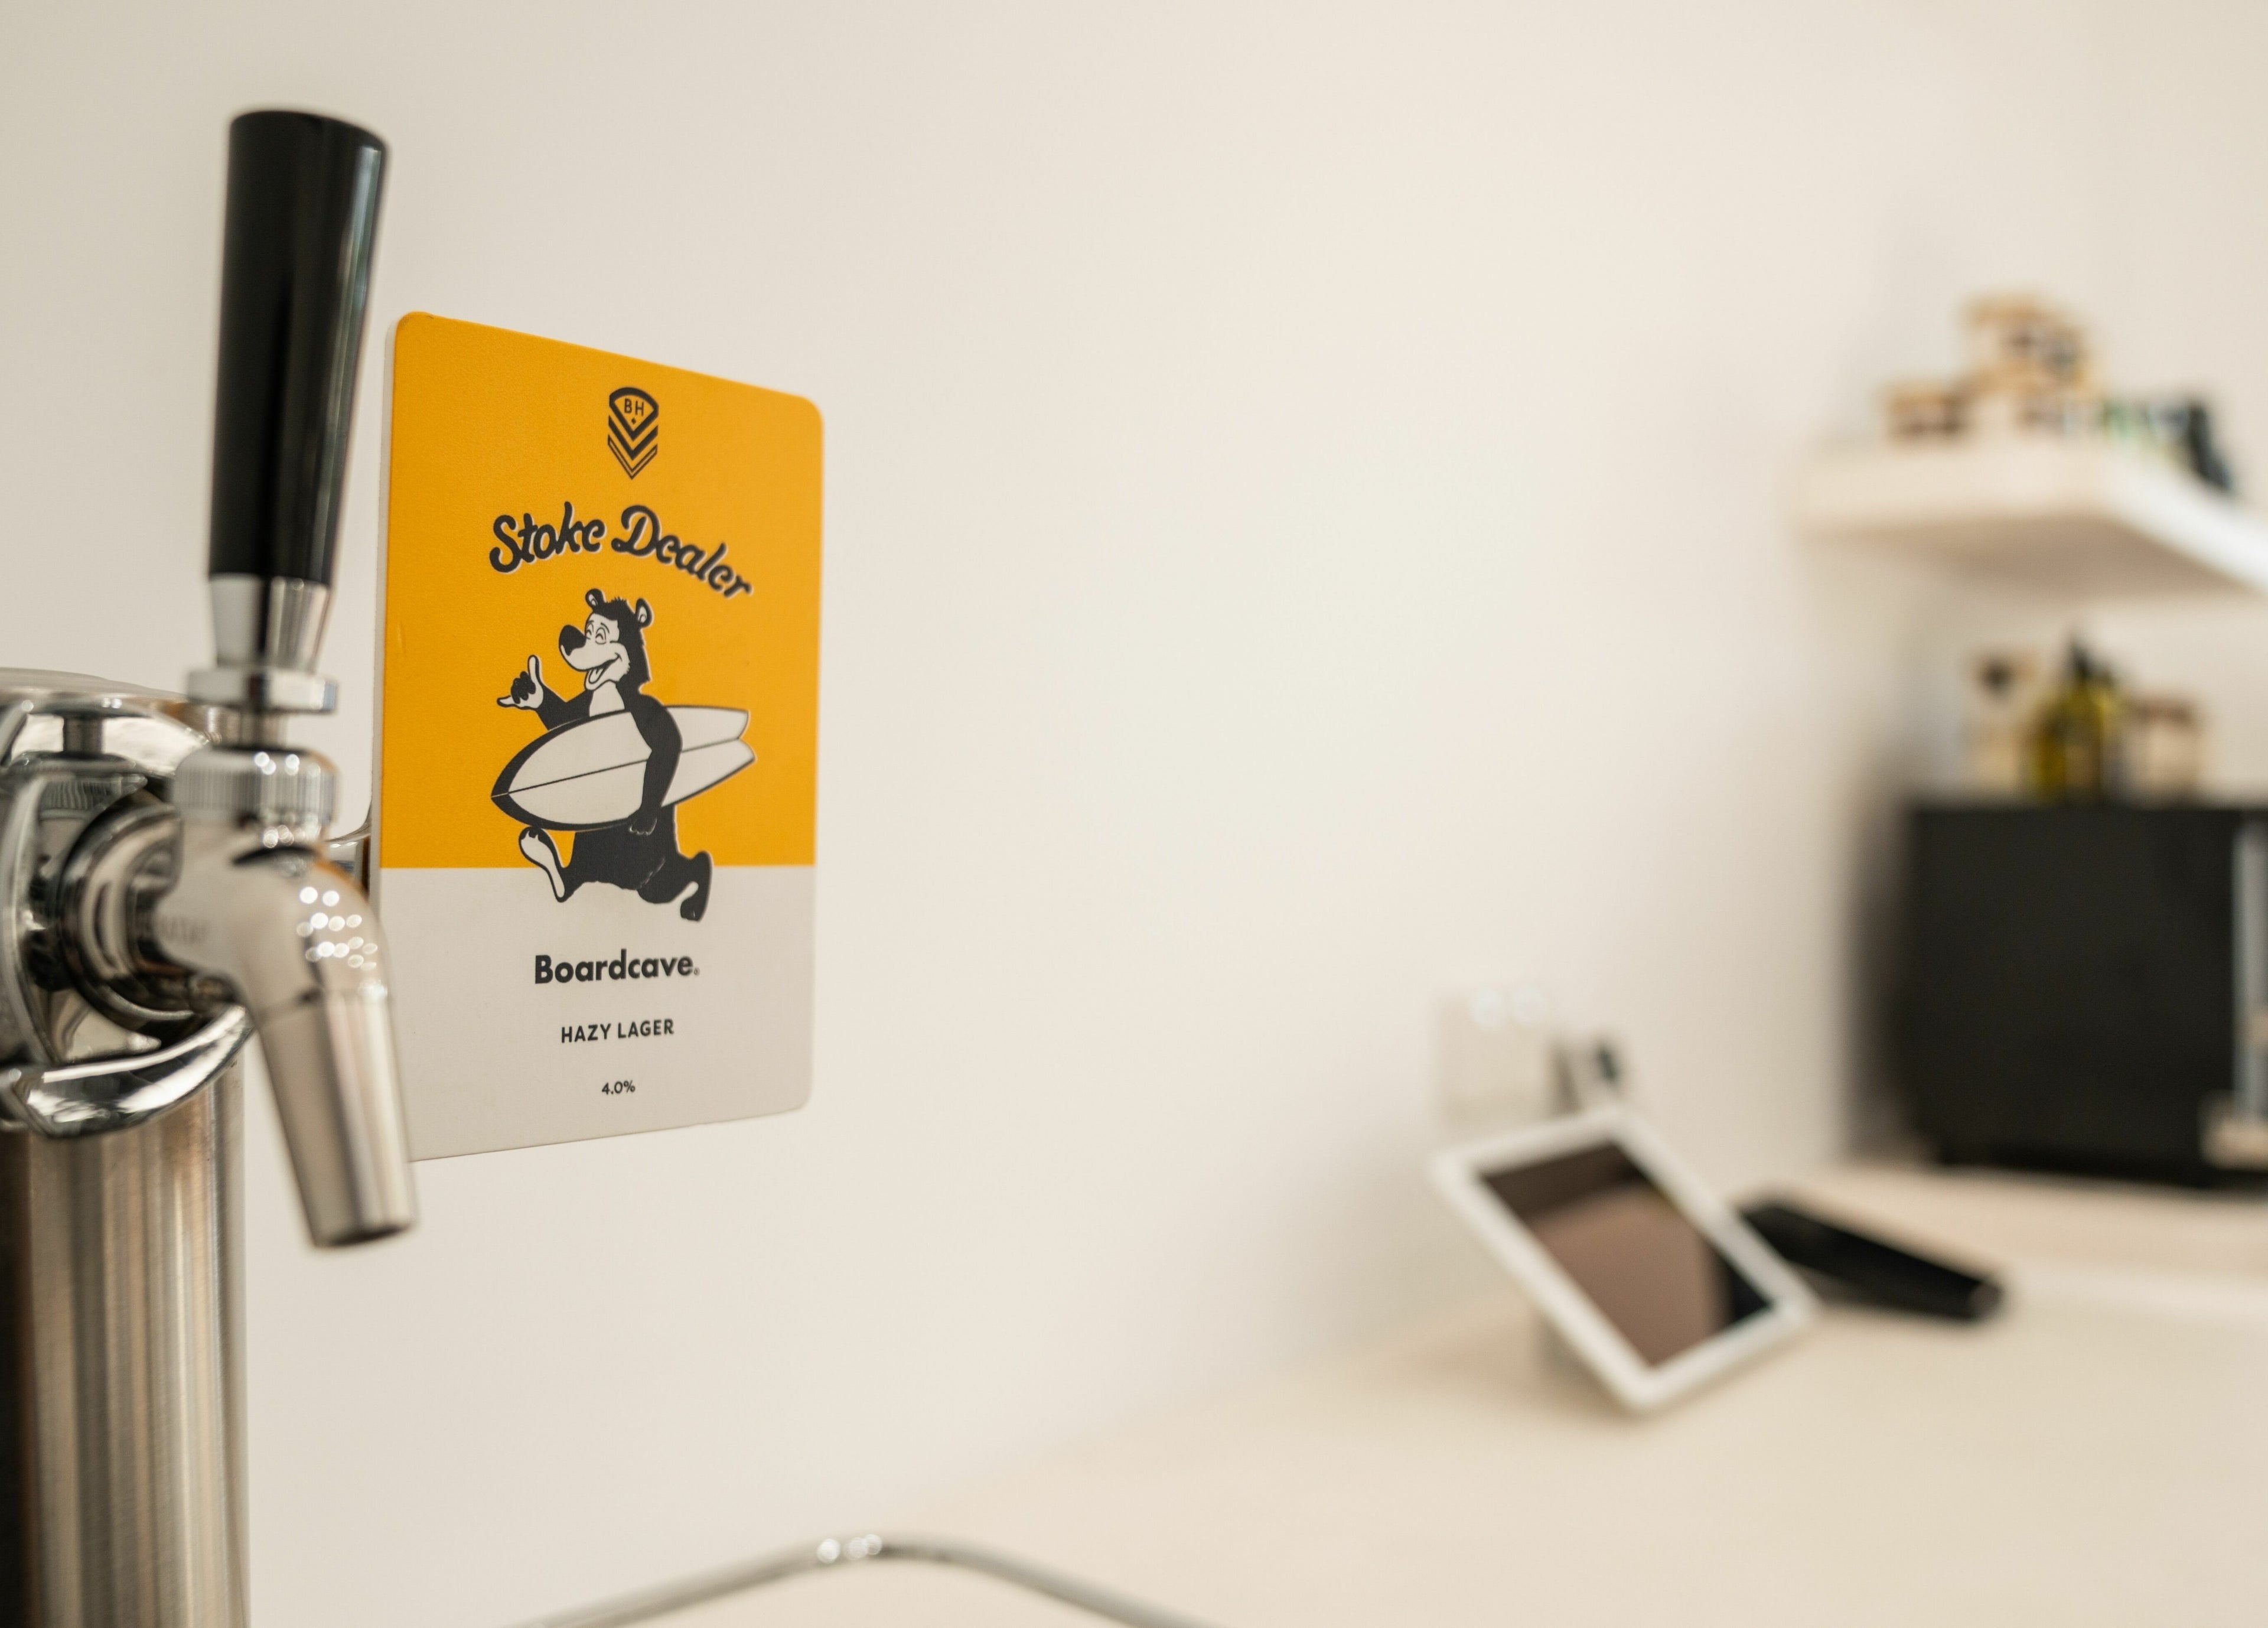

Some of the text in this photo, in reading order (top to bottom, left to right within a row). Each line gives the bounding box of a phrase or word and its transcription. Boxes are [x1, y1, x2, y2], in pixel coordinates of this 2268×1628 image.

[624, 398, 644, 416] BH
[489, 501, 753, 599] Stoke Dealer
[561, 1018, 675, 1044] HAZY LAGER
[601, 1080, 636, 1095] 4.0%
